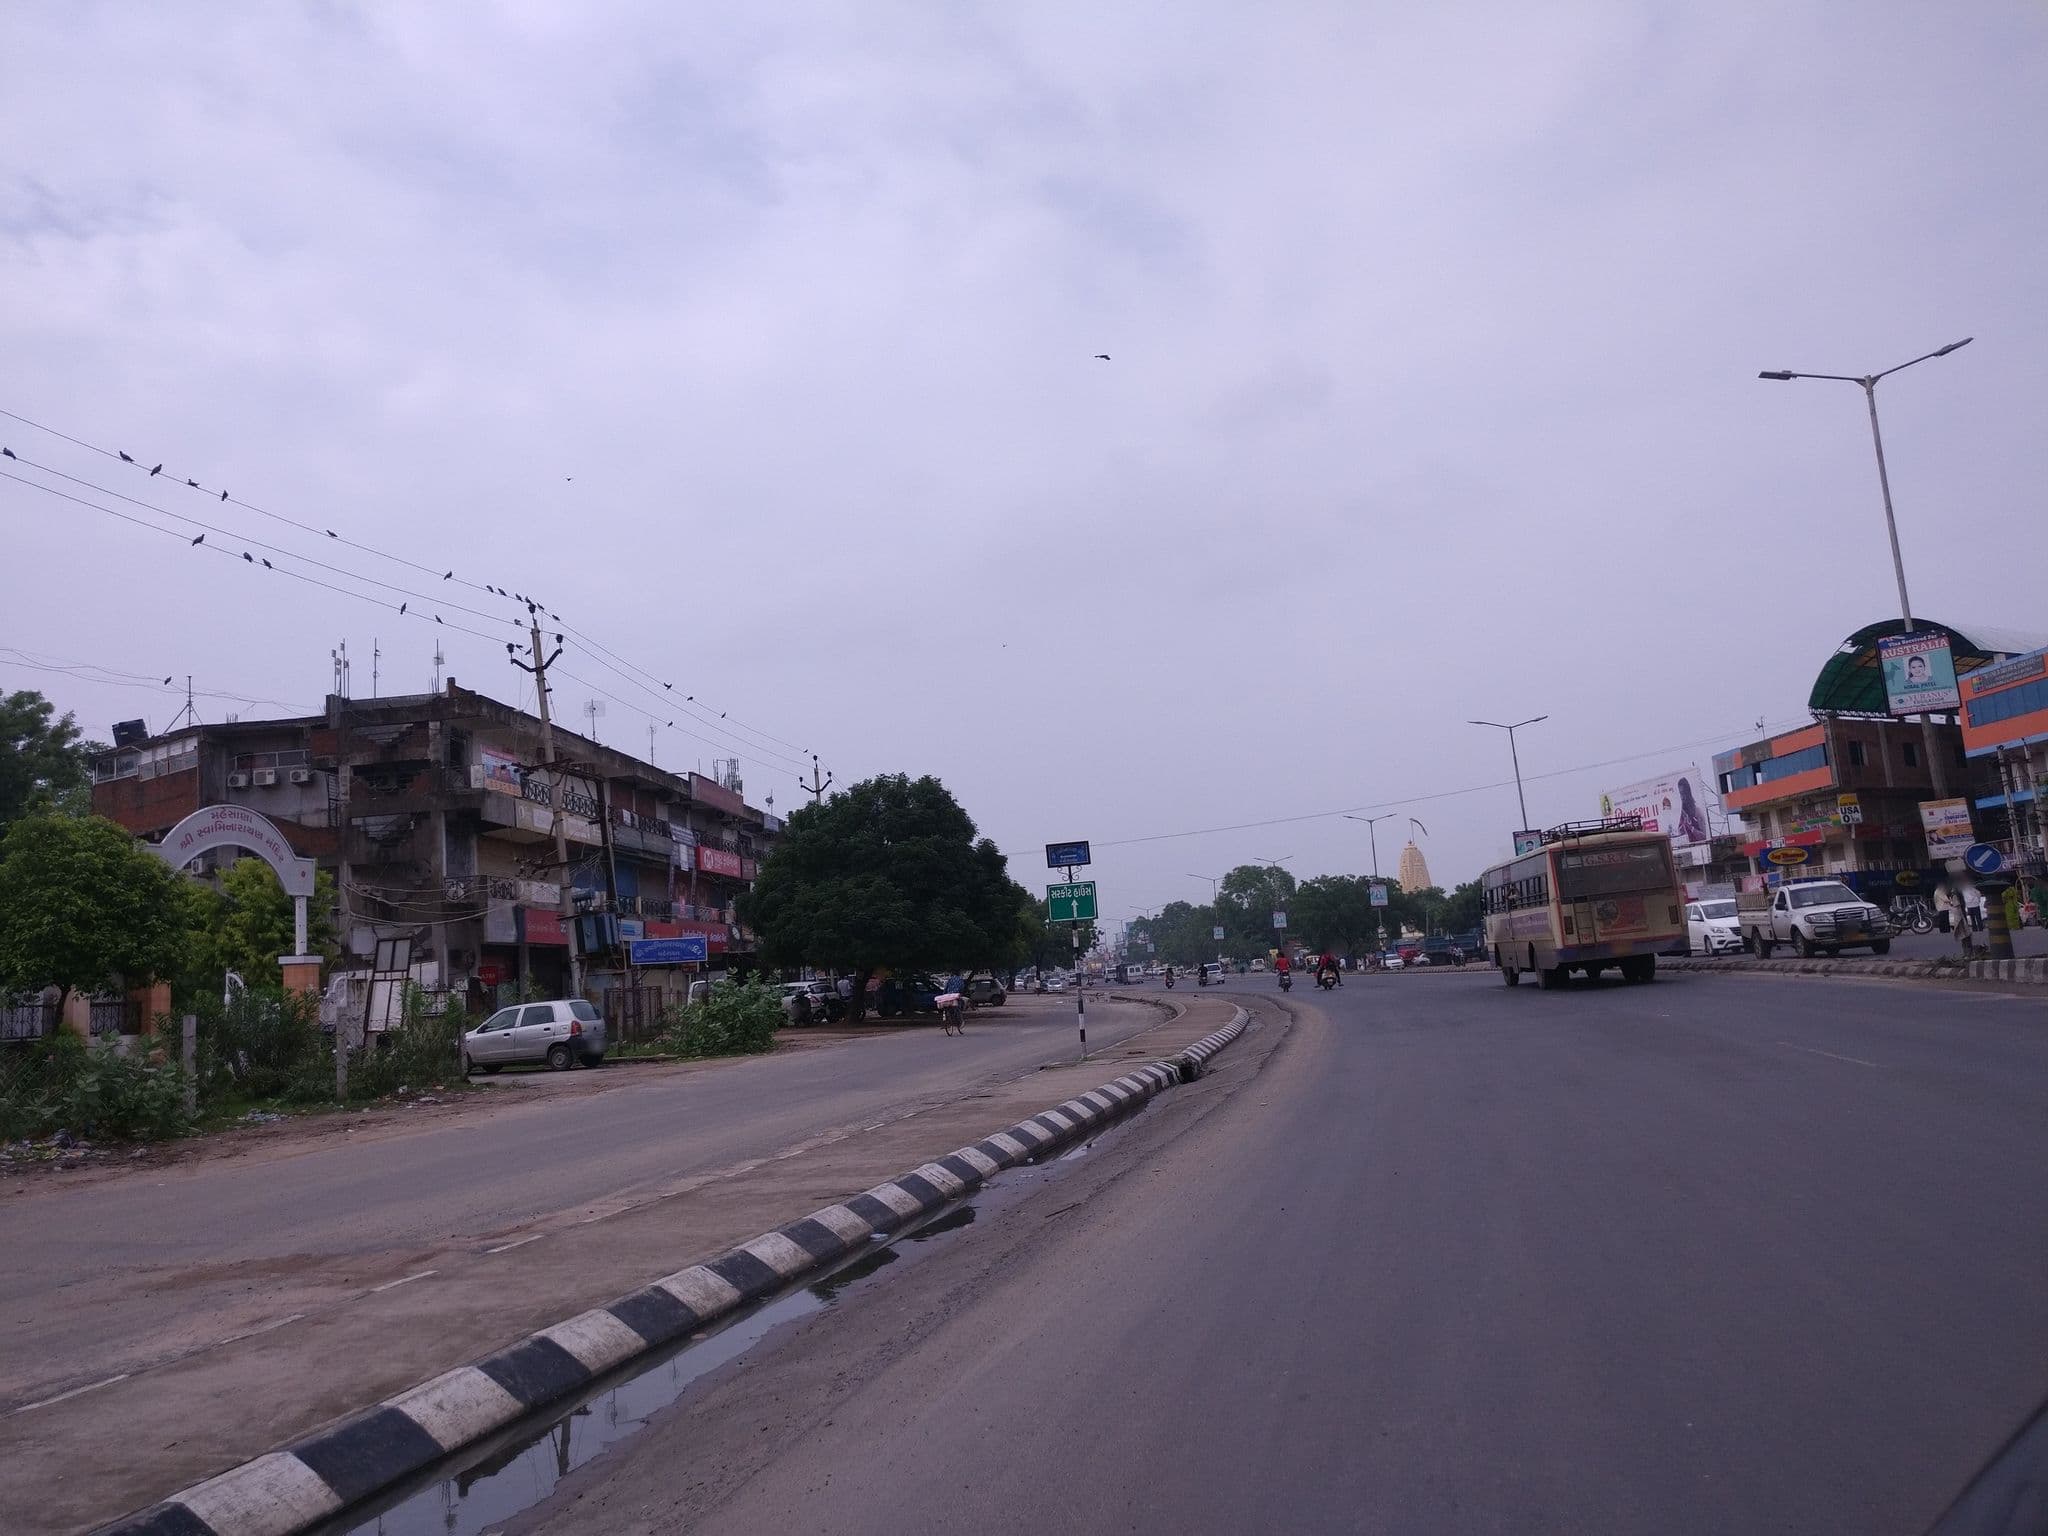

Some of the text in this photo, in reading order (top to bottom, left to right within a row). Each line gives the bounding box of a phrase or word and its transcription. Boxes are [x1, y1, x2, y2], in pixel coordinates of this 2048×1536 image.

[1881, 639, 1948, 658] AUSTRALIA
[211, 808, 253, 823] મહેસાણા
[1840, 806, 1860, 815] USA
[180, 820, 284, 863] શ્રી સ્વામિનારાયણ મંદિર
[1052, 886, 1092, 899] સરકીટ હાઉસ
